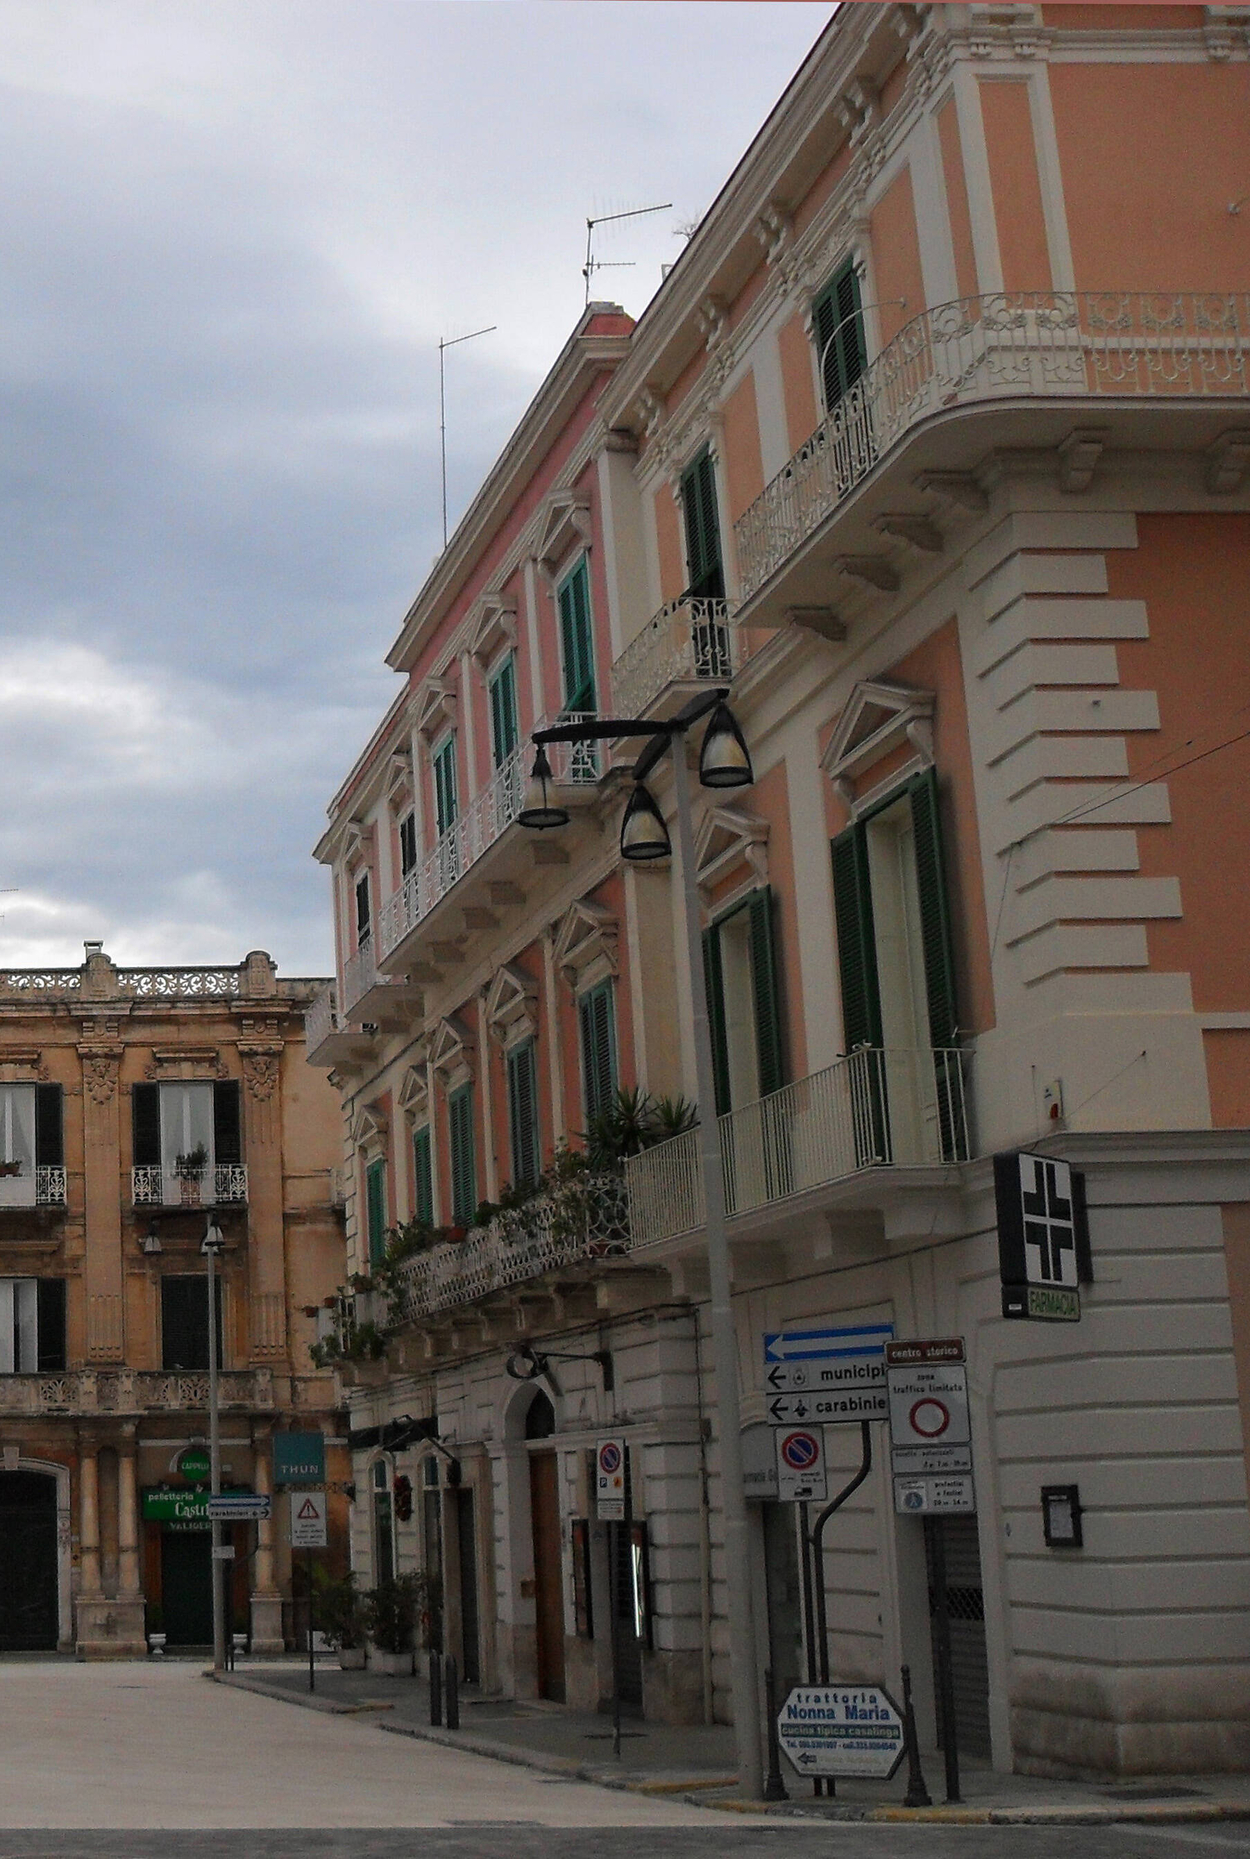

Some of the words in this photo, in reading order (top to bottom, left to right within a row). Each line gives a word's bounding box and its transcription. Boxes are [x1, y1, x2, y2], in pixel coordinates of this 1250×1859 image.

[891, 1349, 922, 1359] centro
[926, 1346, 959, 1357] storico
[820, 1364, 885, 1382] municipi
[917, 1373, 935, 1381] zona
[893, 1384, 925, 1394] traffico
[816, 1399, 886, 1413] carabinie
[280, 1464, 319, 1474] THUN
[148, 1492, 194, 1502] pelletteria
[169, 1521, 212, 1530] VALIGER
[796, 1692, 877, 1704] trattoria
[787, 1704, 836, 1720] Nonna
[844, 1704, 890, 1720] Maria
[782, 1725, 815, 1736] cucina
[817, 1725, 846, 1737] tipica
[848, 1727, 899, 1739] casalinga
